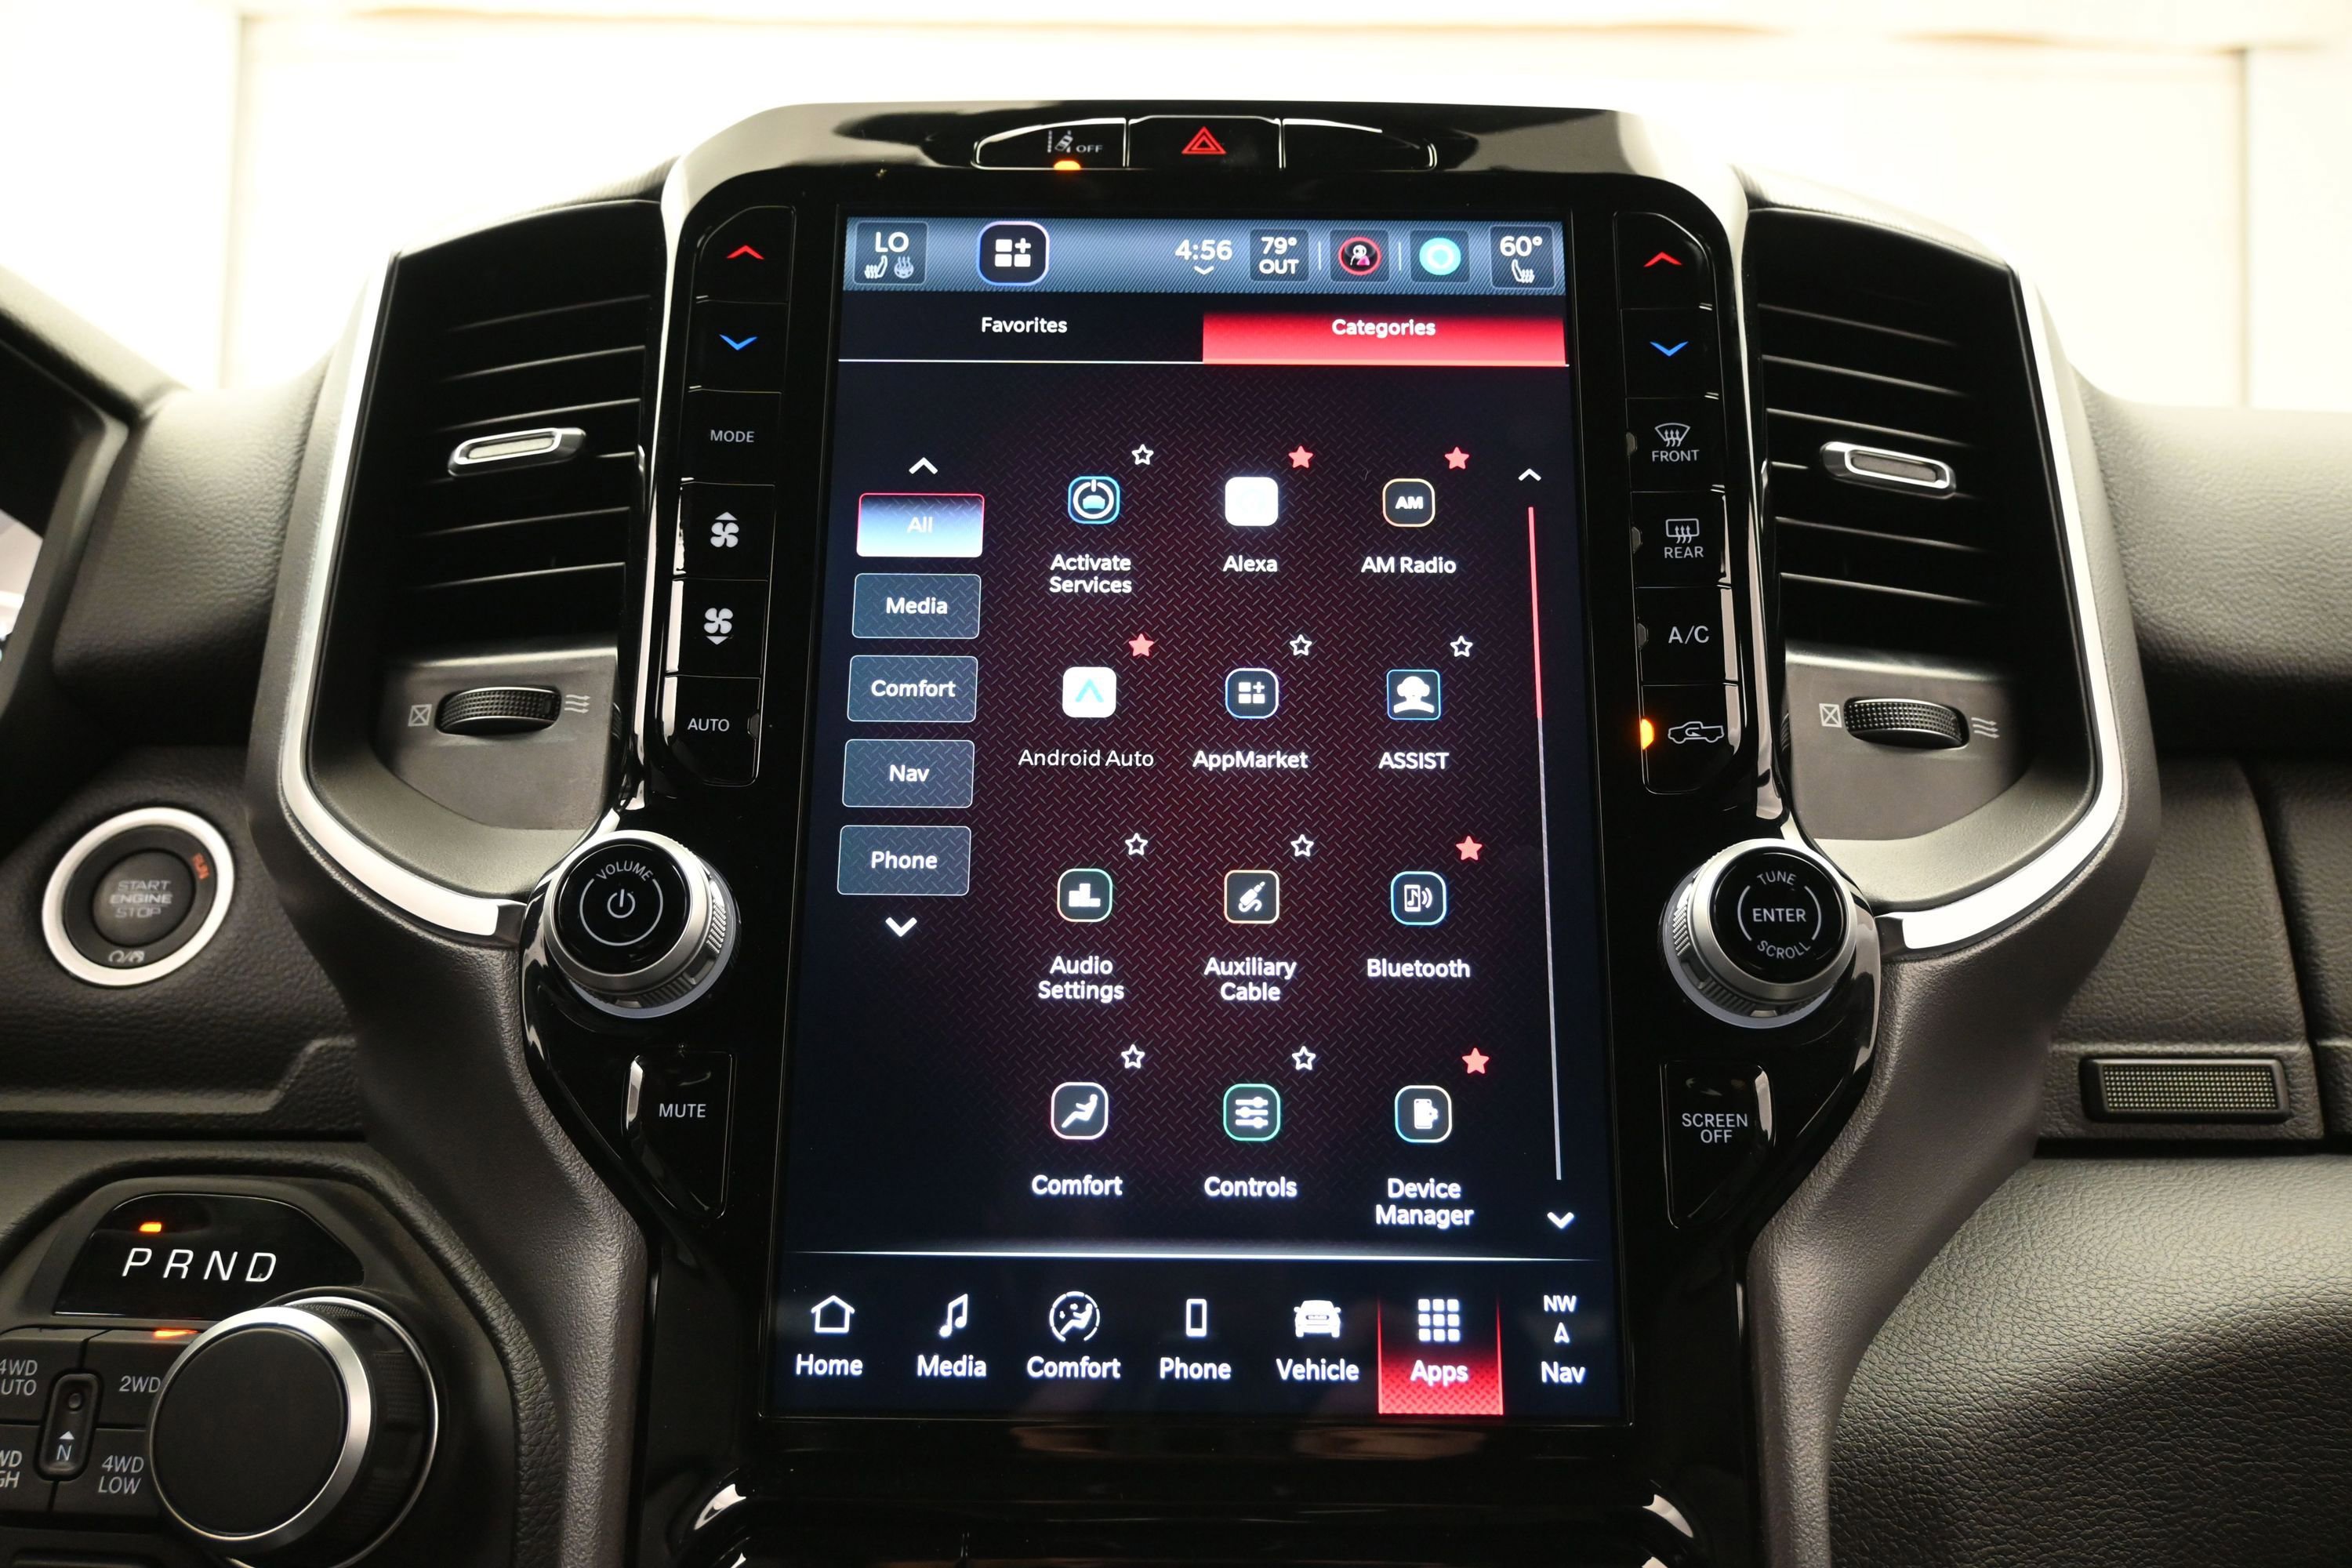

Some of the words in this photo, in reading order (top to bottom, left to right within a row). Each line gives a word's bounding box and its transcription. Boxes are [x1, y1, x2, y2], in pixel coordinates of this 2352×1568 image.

[1075, 143, 1104, 154] OFF
[875, 231, 909, 252] LO
[1174, 239, 1232, 260] 4:56
[1258, 259, 1300, 274] OUT
[982, 317, 1068, 333] Favorites
[1331, 318, 1436, 339] Categories
[710, 429, 754, 443] MODE
[1652, 449, 1699, 462] FRONT
[1395, 495, 1424, 510] AM
[906, 514, 933, 534] All
[1664, 546, 1704, 559] REAR
[1050, 554, 1131, 572] Activate
[1222, 554, 1278, 572] Alexa
[1360, 556, 1396, 573] AM
[1399, 556, 1457, 574] Radio
[1049, 575, 1132, 593] Services
[886, 597, 948, 615] Media
[1668, 625, 1709, 644] A/C
[871, 679, 956, 698] Comfort
[688, 717, 730, 731] AUTO
[1018, 749, 1101, 767] Android
[1105, 750, 1154, 767] Auto
[1192, 750, 1308, 771] AppMarket
[1378, 751, 1450, 770] ASSIST
[889, 764, 930, 782] Nav
[871, 850, 938, 869] Phone
[596, 860, 654, 884] VOLUME
[1757, 870, 1796, 885] TUNE
[118, 880, 170, 891] START
[110, 894, 172, 904] ENGINE
[115, 907, 161, 918] STOP
[1752, 908, 1806, 922] ENTER
[1757, 940, 1811, 959] SCROLL
[1049, 955, 1113, 975] Audio
[1203, 956, 1298, 980] Auxiliary
[1367, 958, 1471, 978] Bluetooth
[1038, 980, 1124, 1004] Settings
[1220, 982, 1281, 1001] Cable
[659, 1103, 706, 1118] MUTE
[1682, 1112, 1748, 1128] SCREEN
[1700, 1130, 1733, 1145] OFF
[1031, 1174, 1123, 1196] Comfort
[1203, 1176, 1298, 1198] Controls
[1388, 1178, 1461, 1200] Device
[1375, 1204, 1475, 1230] Manager
[1543, 1294, 1577, 1312] NW
[796, 1353, 863, 1377] Home
[916, 1354, 987, 1377] Media
[1026, 1356, 1121, 1379] Comfort
[1160, 1356, 1232, 1381] Phone
[1276, 1358, 1359, 1381] Vehicle
[1410, 1359, 1469, 1387] Apps
[1541, 1360, 1586, 1384] Nav
[0, 1378, 38, 1396] UTO
[118, 1374, 162, 1393] 2WD
[56, 1444, 72, 1461] N
[101, 1454, 144, 1474] 4WD
[97, 1476, 142, 1495] LOW
